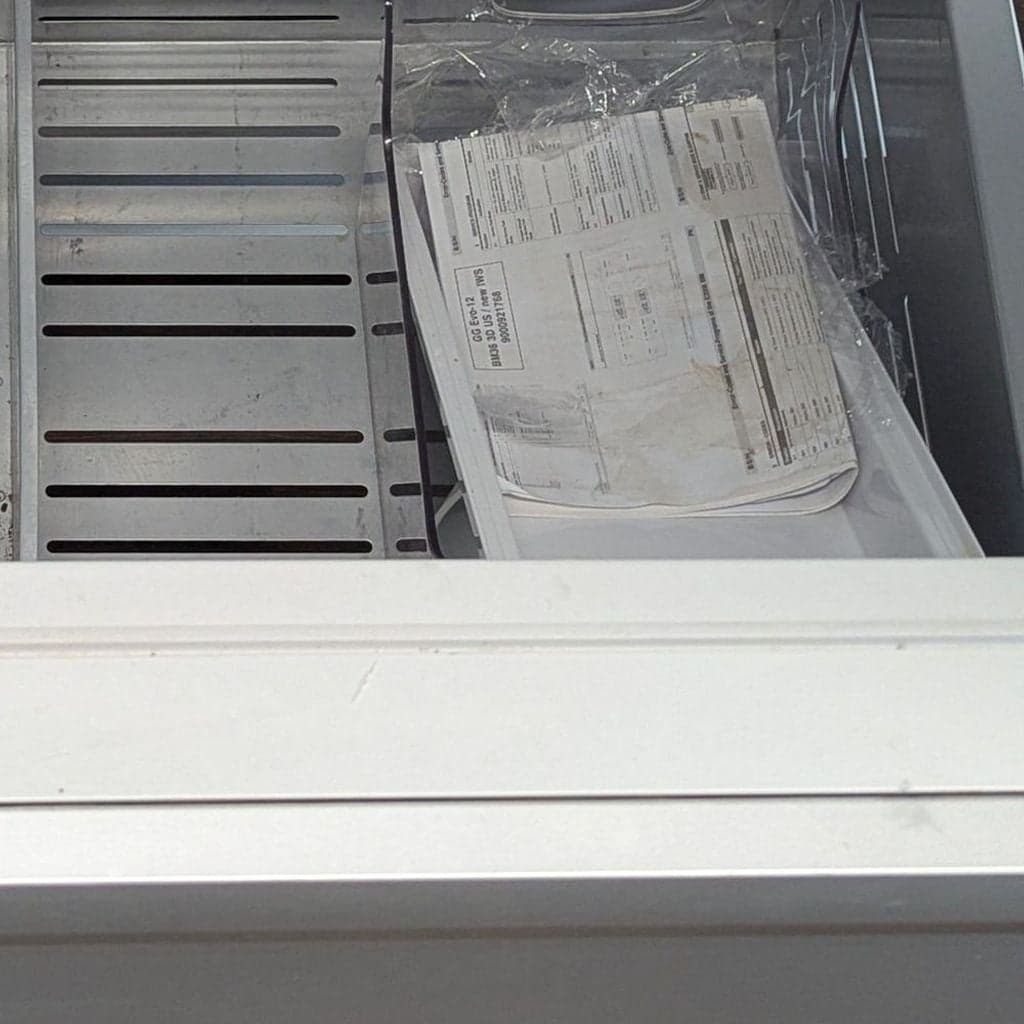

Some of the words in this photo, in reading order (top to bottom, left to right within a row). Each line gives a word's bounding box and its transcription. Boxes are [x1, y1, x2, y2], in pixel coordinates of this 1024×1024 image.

[479, 289, 489, 307] new
[465, 296, 480, 327] Evo-12
[482, 314, 494, 328] US
[471, 328, 483, 342] GG
[485, 329, 496, 341] 3D
